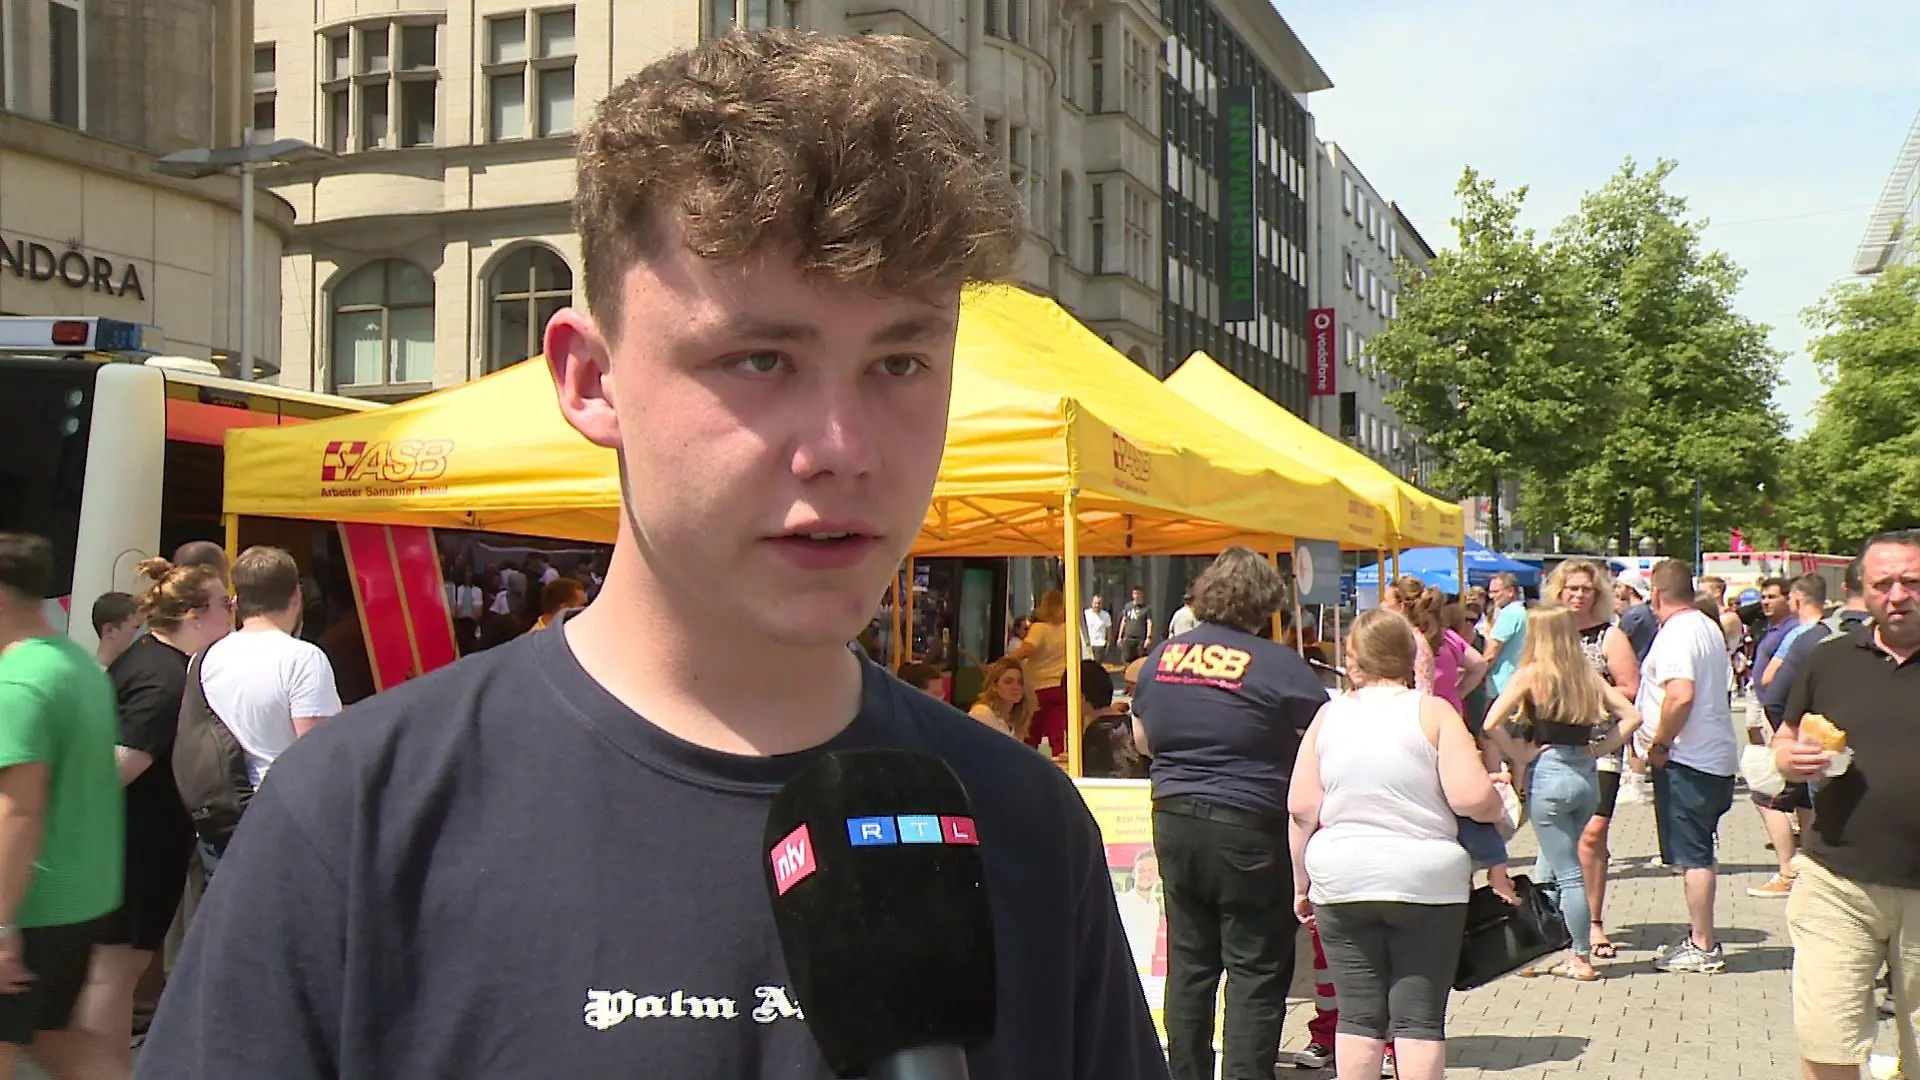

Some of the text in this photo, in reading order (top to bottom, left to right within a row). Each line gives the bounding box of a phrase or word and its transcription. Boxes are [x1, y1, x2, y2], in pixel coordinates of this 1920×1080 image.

[1229, 106, 1250, 301] DEICHMANN
[1317, 332, 1327, 391] vodafone
[349, 439, 455, 482] ASB
[1174, 643, 1252, 680] ASB
[861, 822, 968, 840] RTL
[777, 839, 805, 881] ntv
[584, 985, 804, 1030] Palm A
